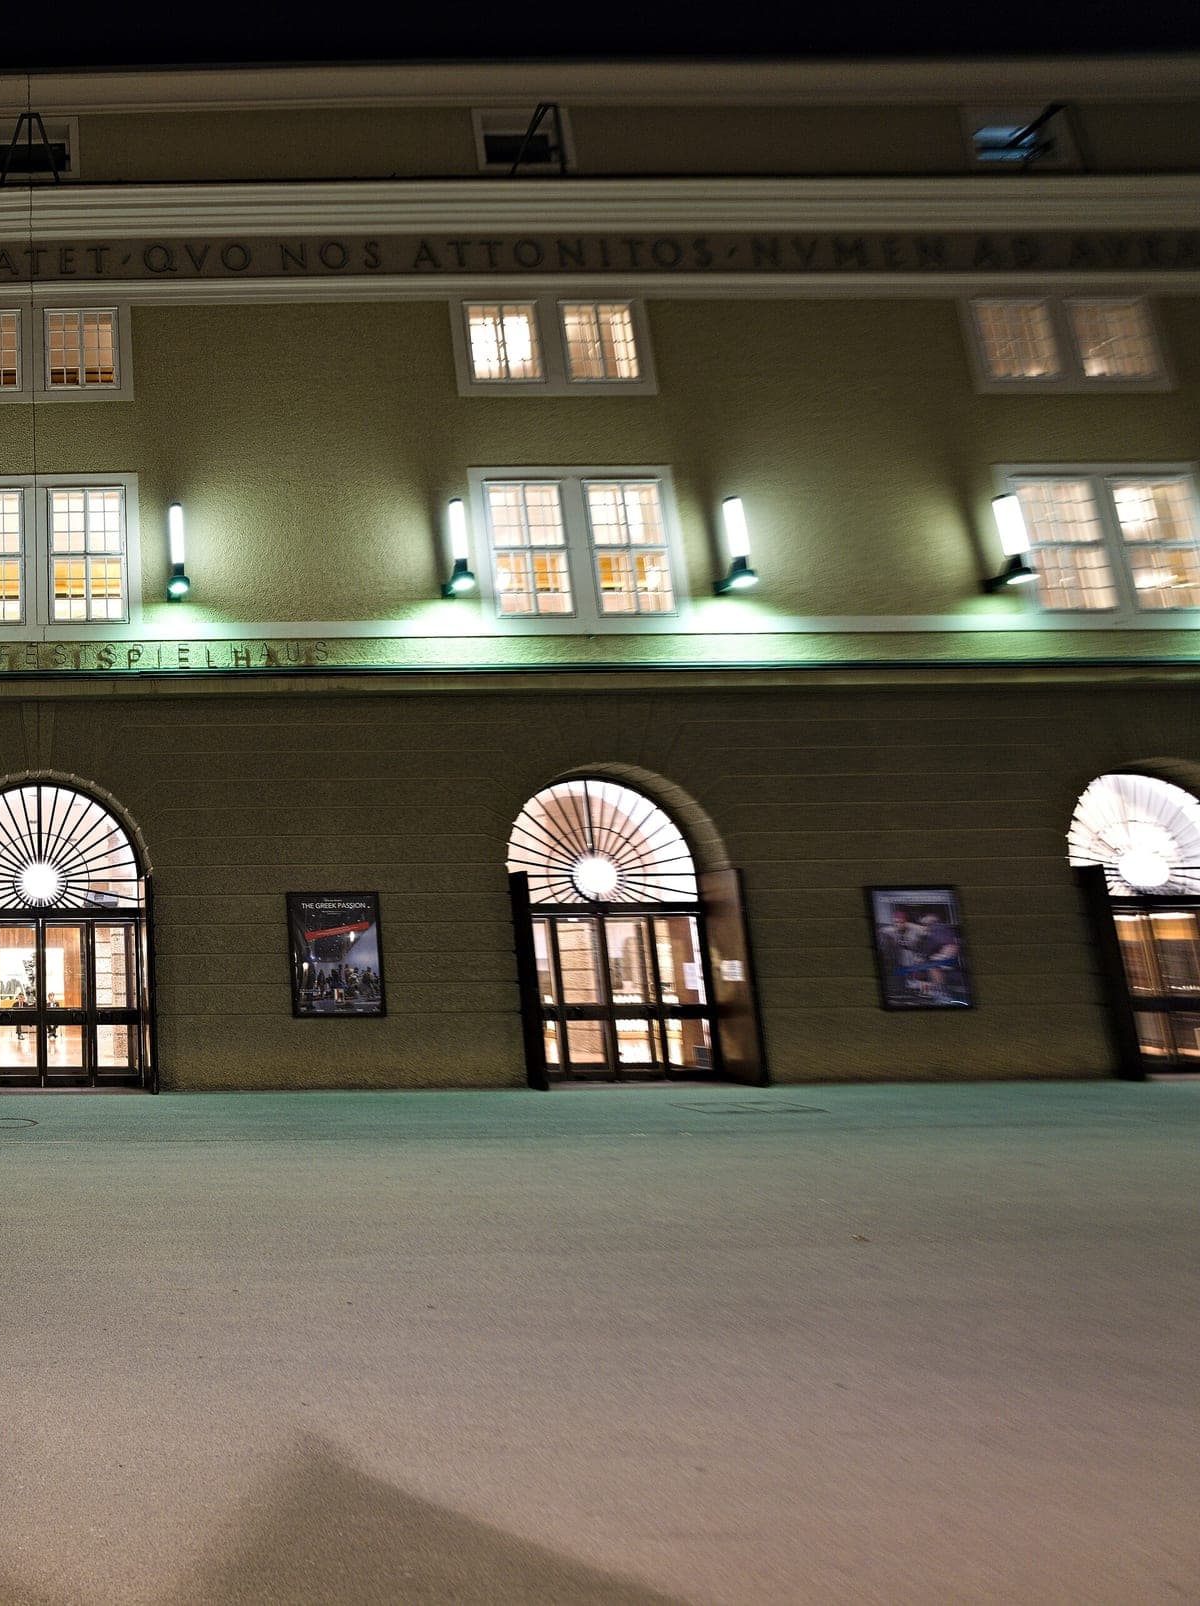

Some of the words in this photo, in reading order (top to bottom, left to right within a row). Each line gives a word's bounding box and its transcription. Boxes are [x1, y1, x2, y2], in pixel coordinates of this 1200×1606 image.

[144, 243, 252, 275] QVO
[280, 240, 383, 271] NOS
[412, 237, 712, 270] ATTONITOS
[0, 641, 329, 667] FESTSPIELHAUS
